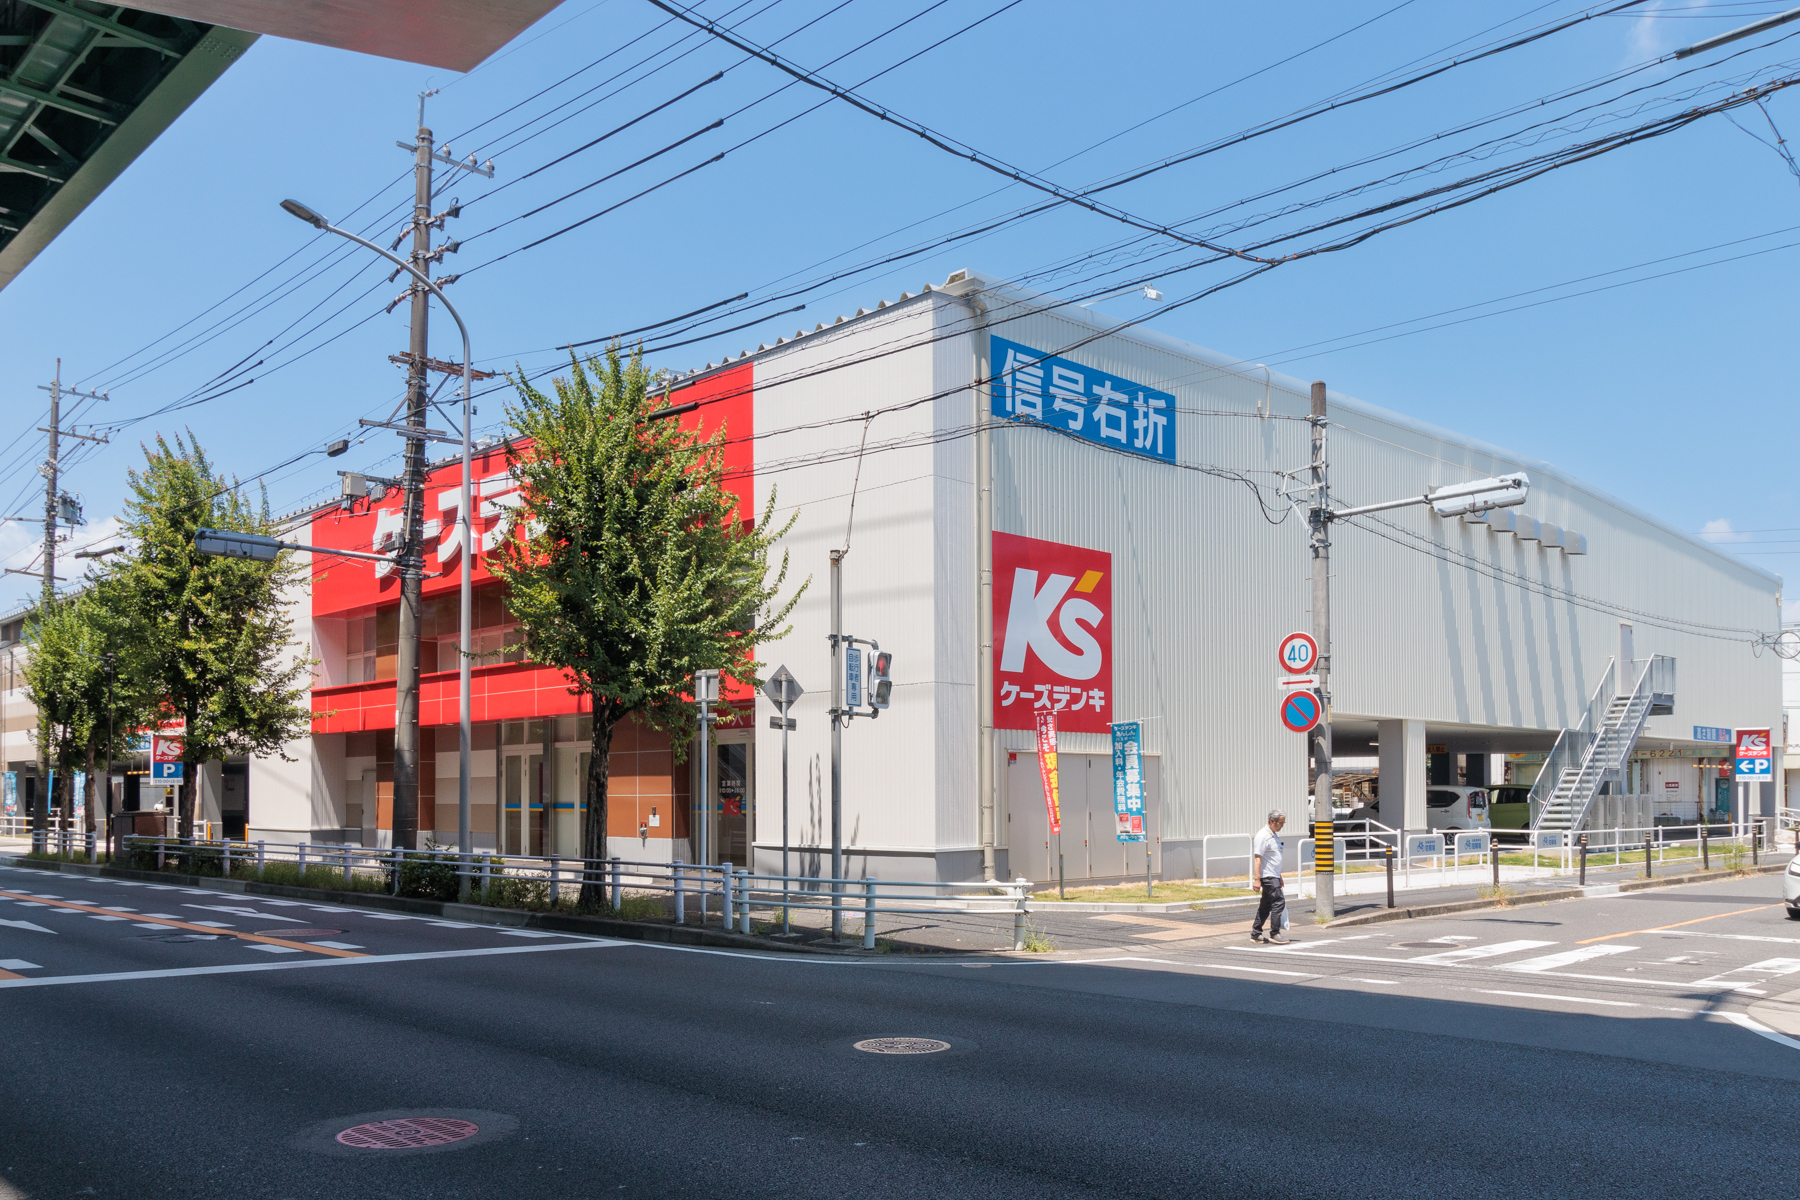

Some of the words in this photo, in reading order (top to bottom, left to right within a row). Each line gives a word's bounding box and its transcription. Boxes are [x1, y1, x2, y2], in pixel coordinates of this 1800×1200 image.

[1001, 347, 1167, 455] 信号右折
[1000, 567, 1104, 680] K's
[1287, 644, 1309, 663] 40
[1000, 680, 1105, 712] ケーズデンキ
[1629, 749, 1682, 758] 1-6221
[1739, 732, 1767, 750] K's
[163, 763, 175, 777] P
[1114, 742, 1126, 811] 加入料・年会費無料
[1124, 740, 1141, 811] 会員募集中
[1755, 759, 1769, 773] P
